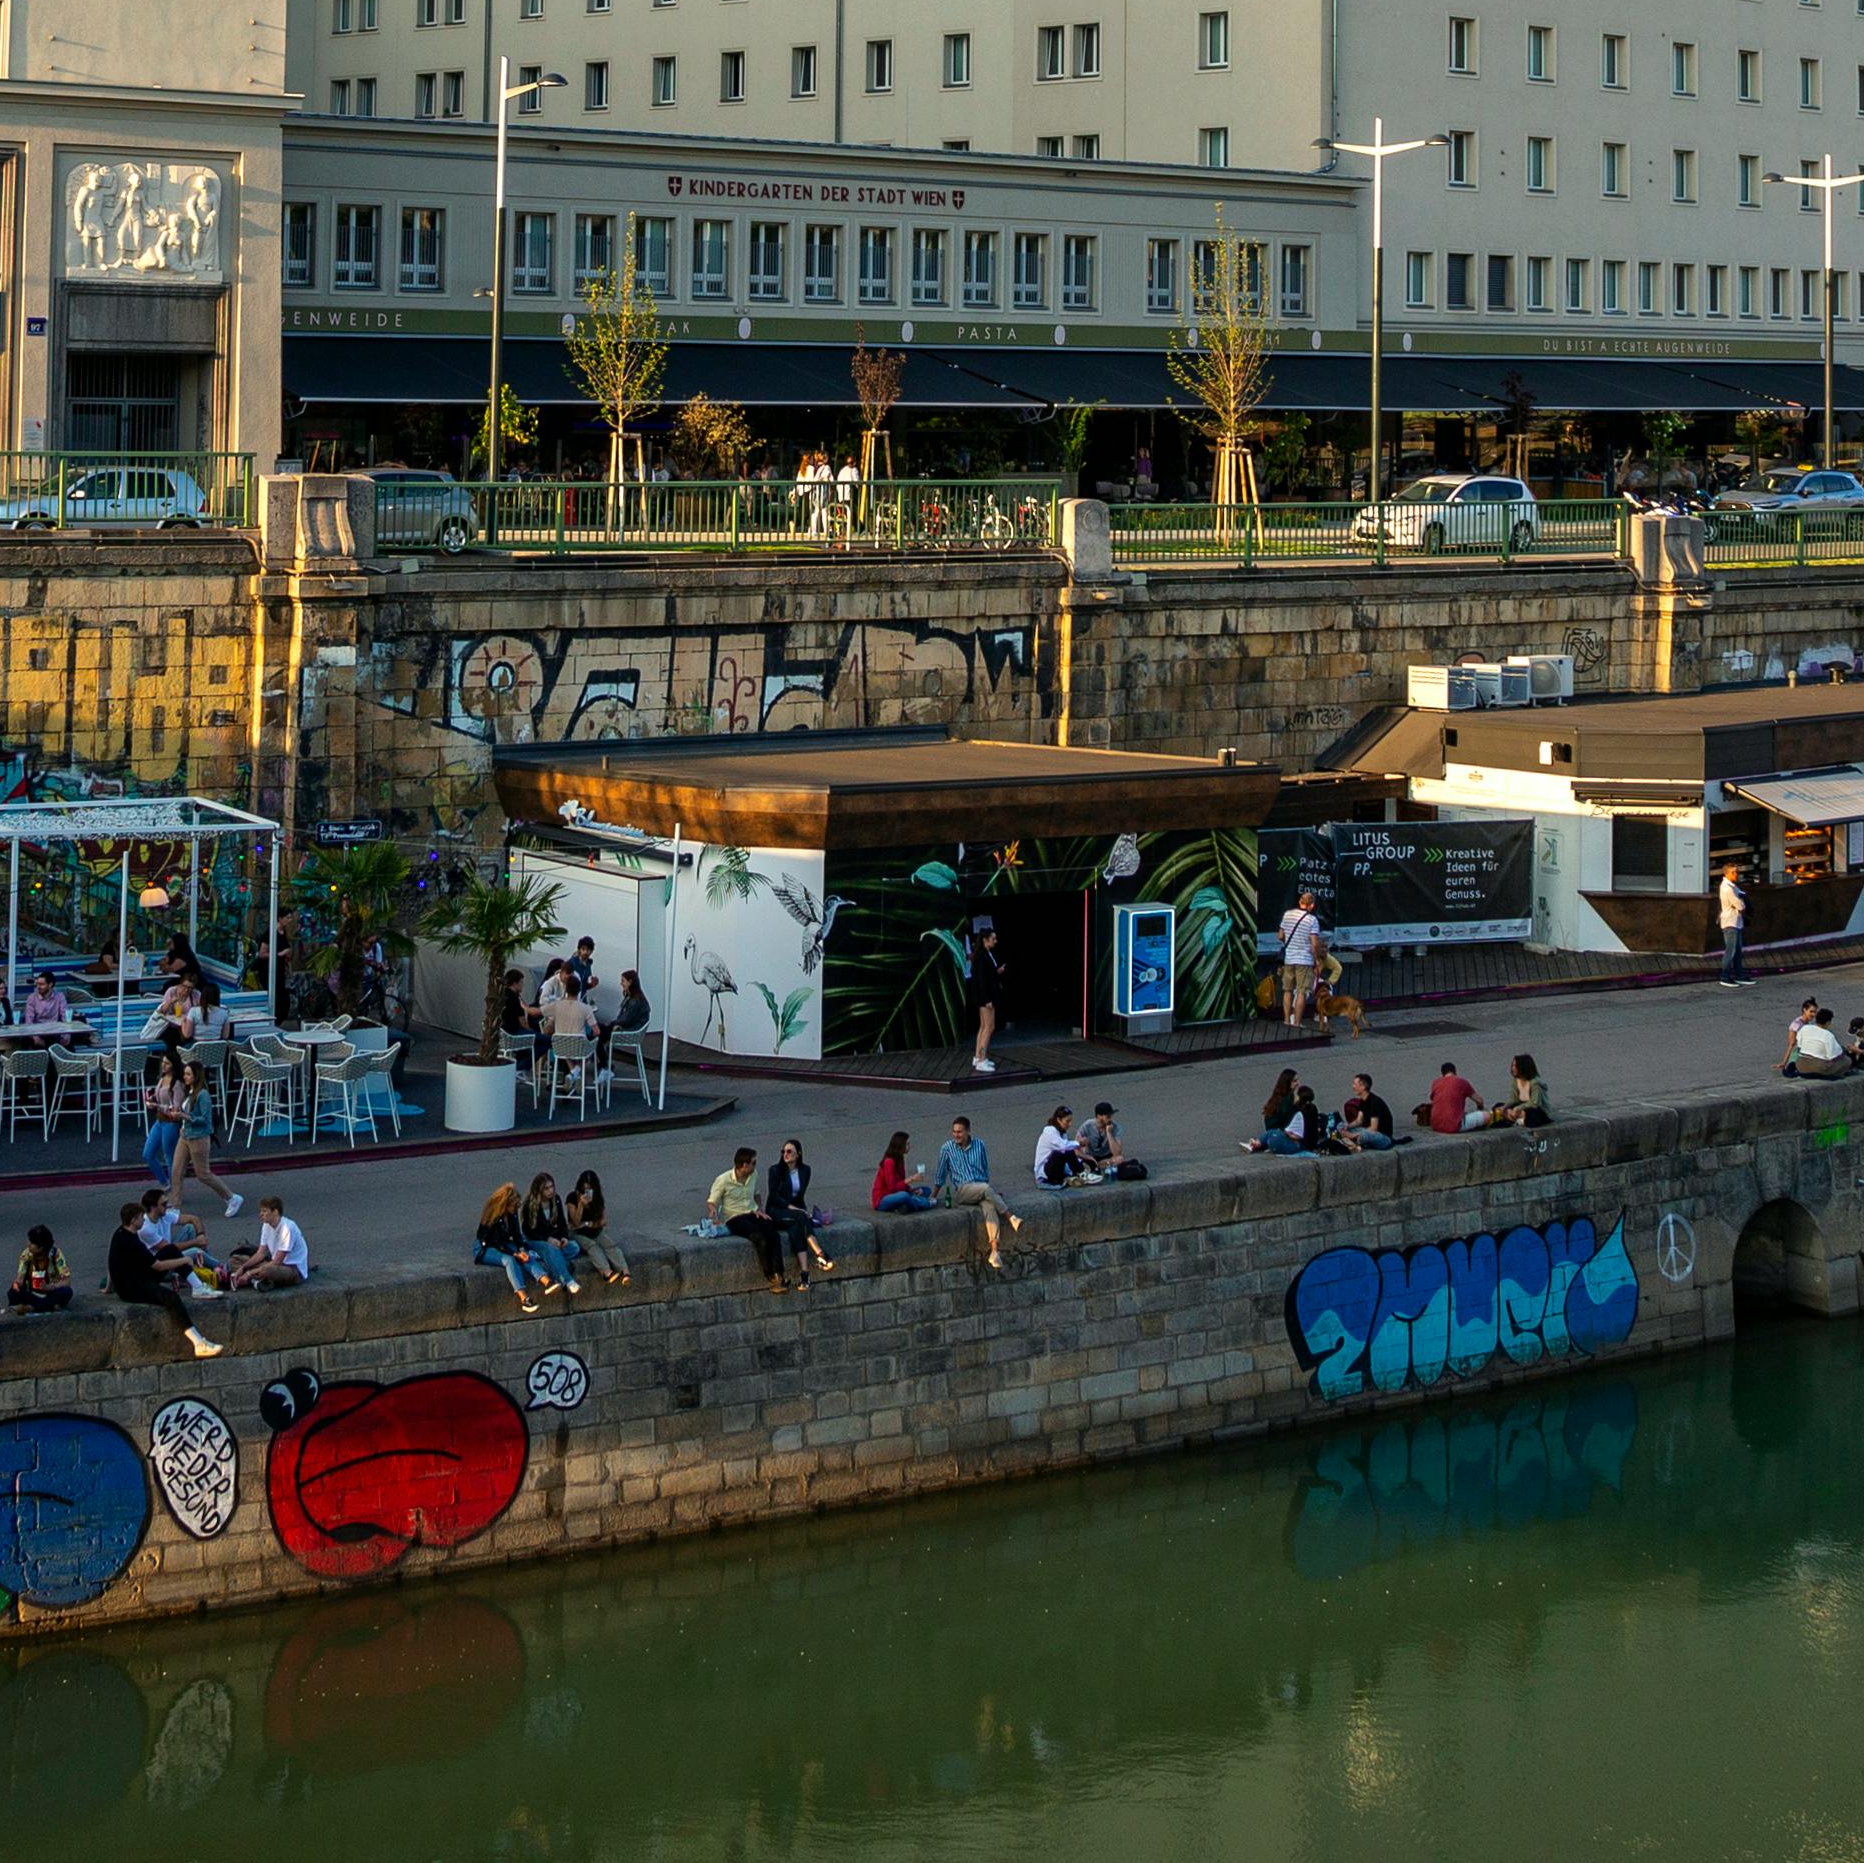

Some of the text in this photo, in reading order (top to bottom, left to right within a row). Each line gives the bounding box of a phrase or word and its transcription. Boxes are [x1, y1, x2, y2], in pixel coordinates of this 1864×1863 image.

[689, 179, 946, 206] KINDERGARTEN DER STADT WIEN
[957, 326, 1017, 340] PASTA
[1543, 339, 1730, 354] DU BIST A ECHTE AUGENWEIDE
[1352, 832, 1390, 846] LITUS
[1366, 845, 1416, 860] GROUP
[1445, 848, 1495, 860] Kreative
[1354, 863, 1373, 876] PP.
[1446, 861, 1499, 873] Ideen für
[1445, 876, 1476, 886] euren
[1445, 889, 1486, 899] Genuss.
[533, 1361, 582, 1402] 508
[174, 1403, 234, 1462] WERD
[158, 1415, 231, 1509] WIEDER
[162, 1456, 220, 1533] GESUND
